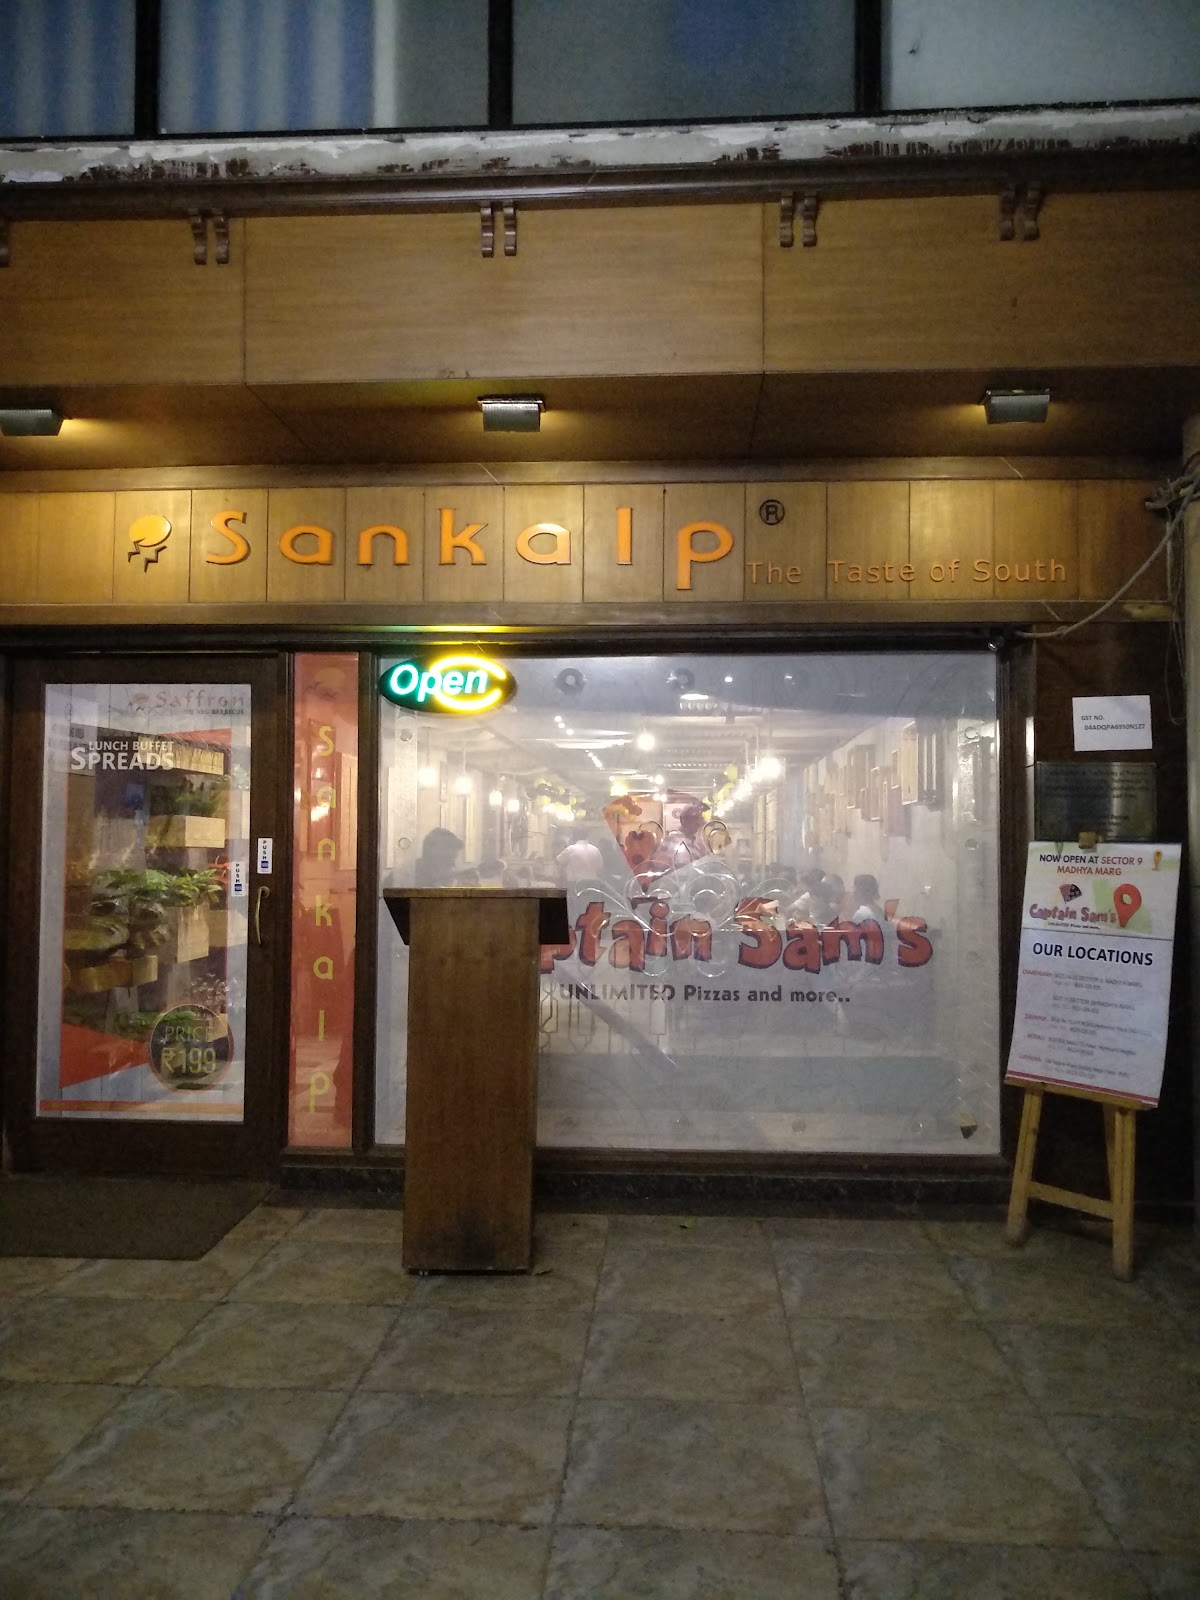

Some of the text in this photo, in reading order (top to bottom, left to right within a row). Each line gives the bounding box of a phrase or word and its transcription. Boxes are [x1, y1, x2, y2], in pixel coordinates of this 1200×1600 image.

[206, 505, 734, 590] Sankalp
[746, 558, 1067, 584] The Taste of South
[389, 664, 488, 702] Open
[89, 741, 175, 751] LUNCH BUFFET
[71, 747, 175, 770] SPREADS
[1040, 854, 1143, 865] NOW OPEN AT SECTOR 9
[1057, 866, 1122, 876] MADHYA MARG
[735, 897, 933, 975] Sam's
[1032, 942, 1154, 966] OUR LOCATIONS
[560, 984, 676, 1000] UNLIMITED
[683, 984, 740, 1002] Pizzas
[747, 984, 782, 1002] and
[165, 1026, 213, 1042] PRICE
